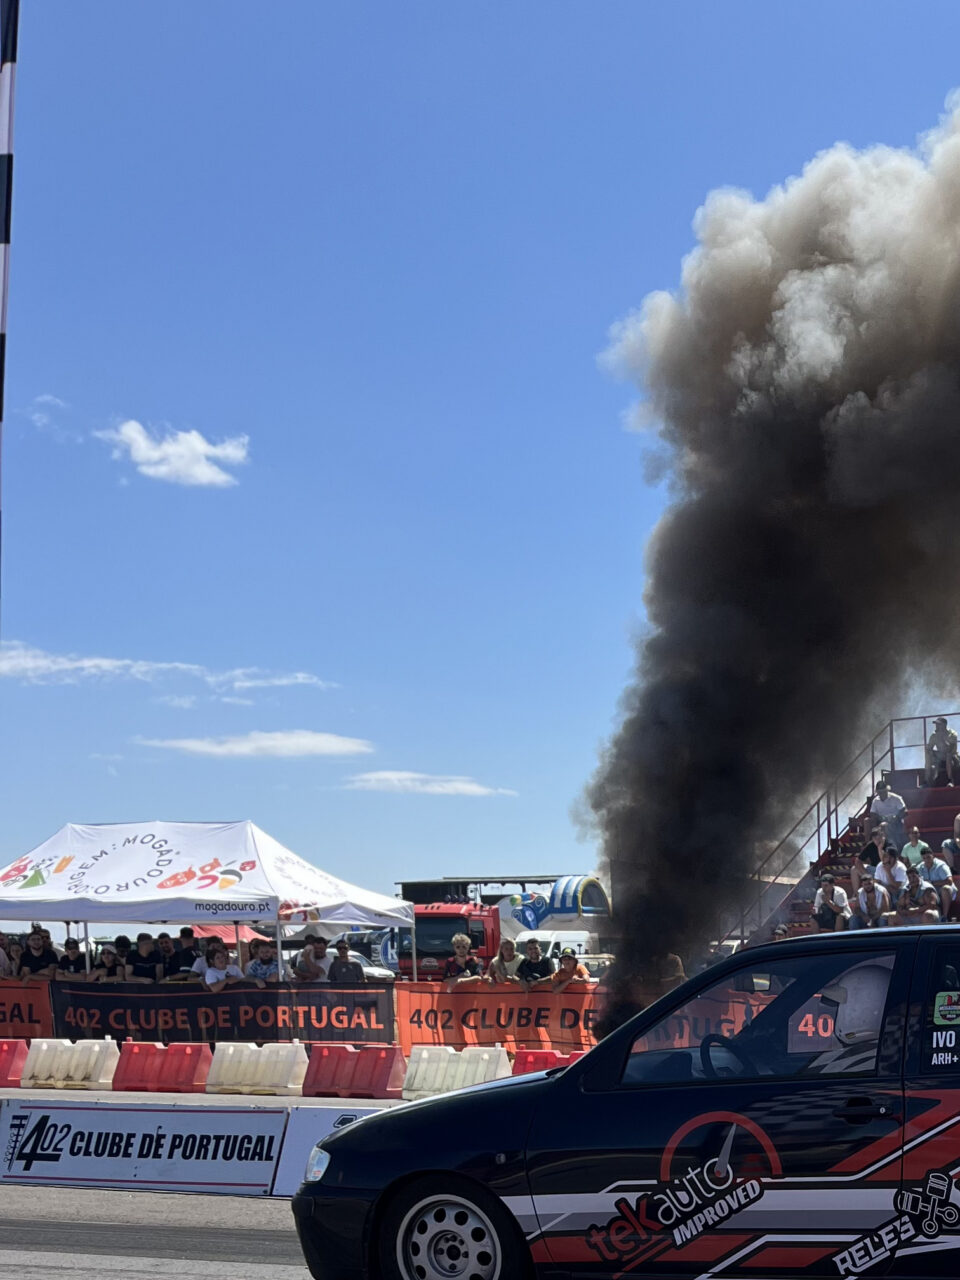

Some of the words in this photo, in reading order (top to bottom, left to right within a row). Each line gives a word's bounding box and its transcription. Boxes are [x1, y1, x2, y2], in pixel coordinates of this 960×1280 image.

[195, 901, 271, 915] mogadouro.pt
[65, 1007, 101, 1028] 402
[108, 1008, 189, 1030] CLUBE
[197, 1007, 231, 1028] DE
[239, 1006, 385, 1029] PORTUGAL
[409, 1008, 455, 1030] 402
[461, 1007, 551, 1030] CLUBE
[560, 1008, 598, 1030] DE
[932, 1030, 956, 1049] IVO
[931, 1052, 959, 1066] ARH+
[16, 1114, 72, 1171] 402
[69, 1130, 137, 1158] CLUBE
[167, 1134, 276, 1162] PORTUGAL
[672, 1179, 761, 1247] IMPROVED
